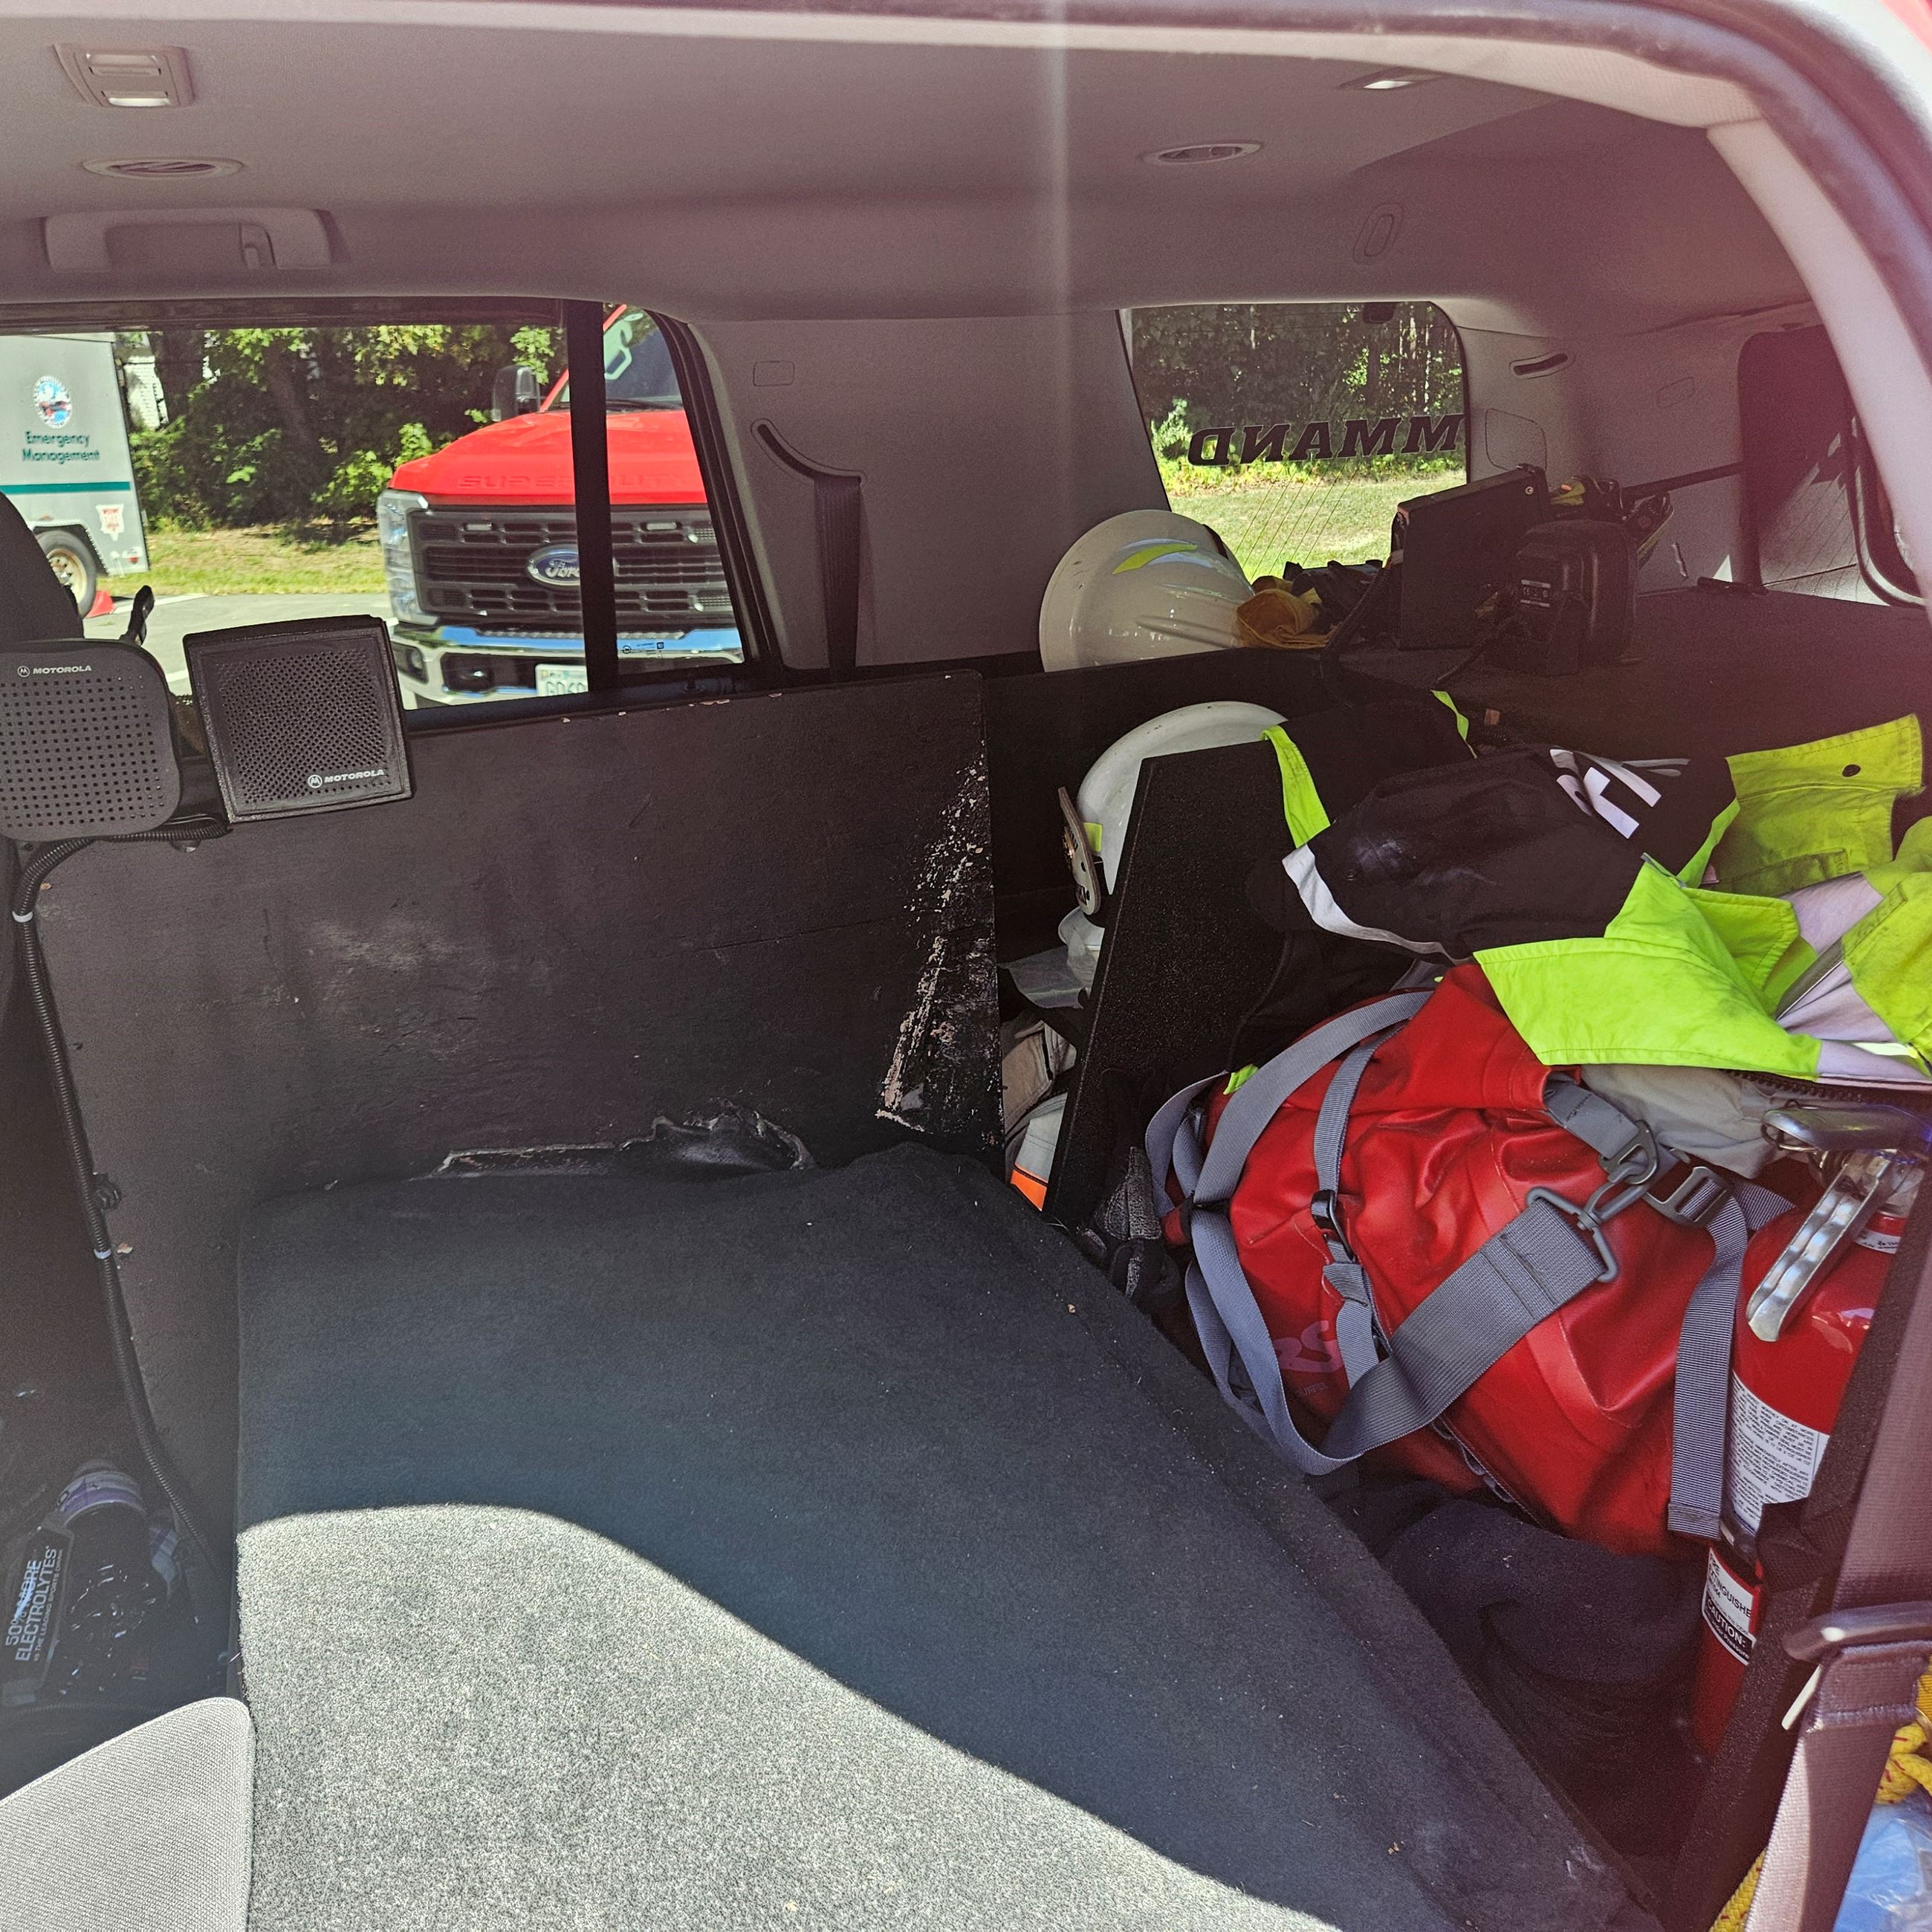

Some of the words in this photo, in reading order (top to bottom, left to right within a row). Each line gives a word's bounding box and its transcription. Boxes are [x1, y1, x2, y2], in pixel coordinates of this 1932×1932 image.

[25, 430, 89, 447] Emergency
[22, 448, 100, 464] Management
[33, 664, 92, 675] MOTOROLA
[324, 768, 385, 783] MOTOROLA
[15, 1547, 56, 1661] ELECTROLYTES
